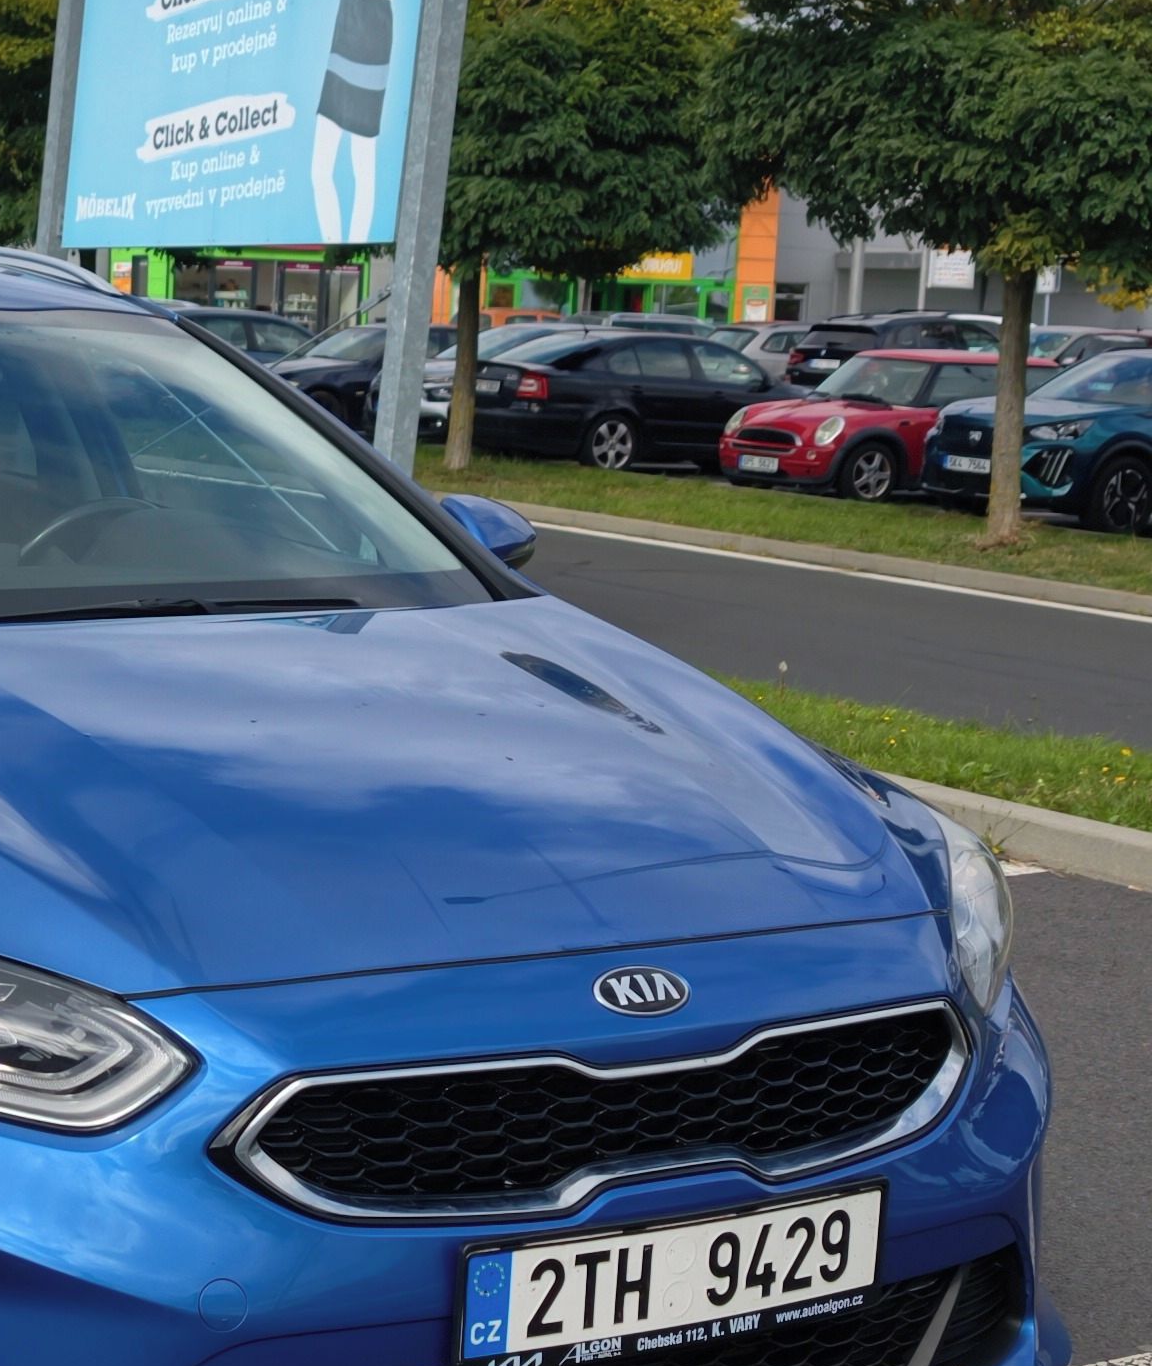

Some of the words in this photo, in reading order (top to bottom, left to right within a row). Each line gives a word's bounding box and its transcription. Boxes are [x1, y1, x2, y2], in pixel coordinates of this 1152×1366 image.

[166, 10, 223, 44] Rezervuj
[226, 0, 272, 26] online
[171, 53, 197, 74] kup
[201, 48, 210, 64] v
[212, 24, 277, 67] prodejně
[153, 119, 194, 150] Click
[199, 115, 210, 140] &
[215, 99, 278, 136] Collect
[171, 160, 198, 182] Kup
[201, 150, 245, 175] online
[250, 144, 260, 165] &
[75, 192, 136, 222] MÖBELIX
[146, 188, 203, 219] vyzvedni
[208, 188, 217, 204] v
[220, 169, 286, 207] prodejně
[606, 972, 681, 1006] KIA
[527, 1244, 654, 1338] 2TH
[707, 1209, 852, 1307] 9429
[776, 1294, 863, 1323] www.autoalgon.cz
[470, 1319, 501, 1346] CZ
[559, 1336, 622, 1366] ALGON
[637, 1330, 682, 1351] Chebská
[686, 1327, 707, 1342] 112,
[712, 1321, 724, 1337] K.
[729, 1313, 761, 1334] VARY
